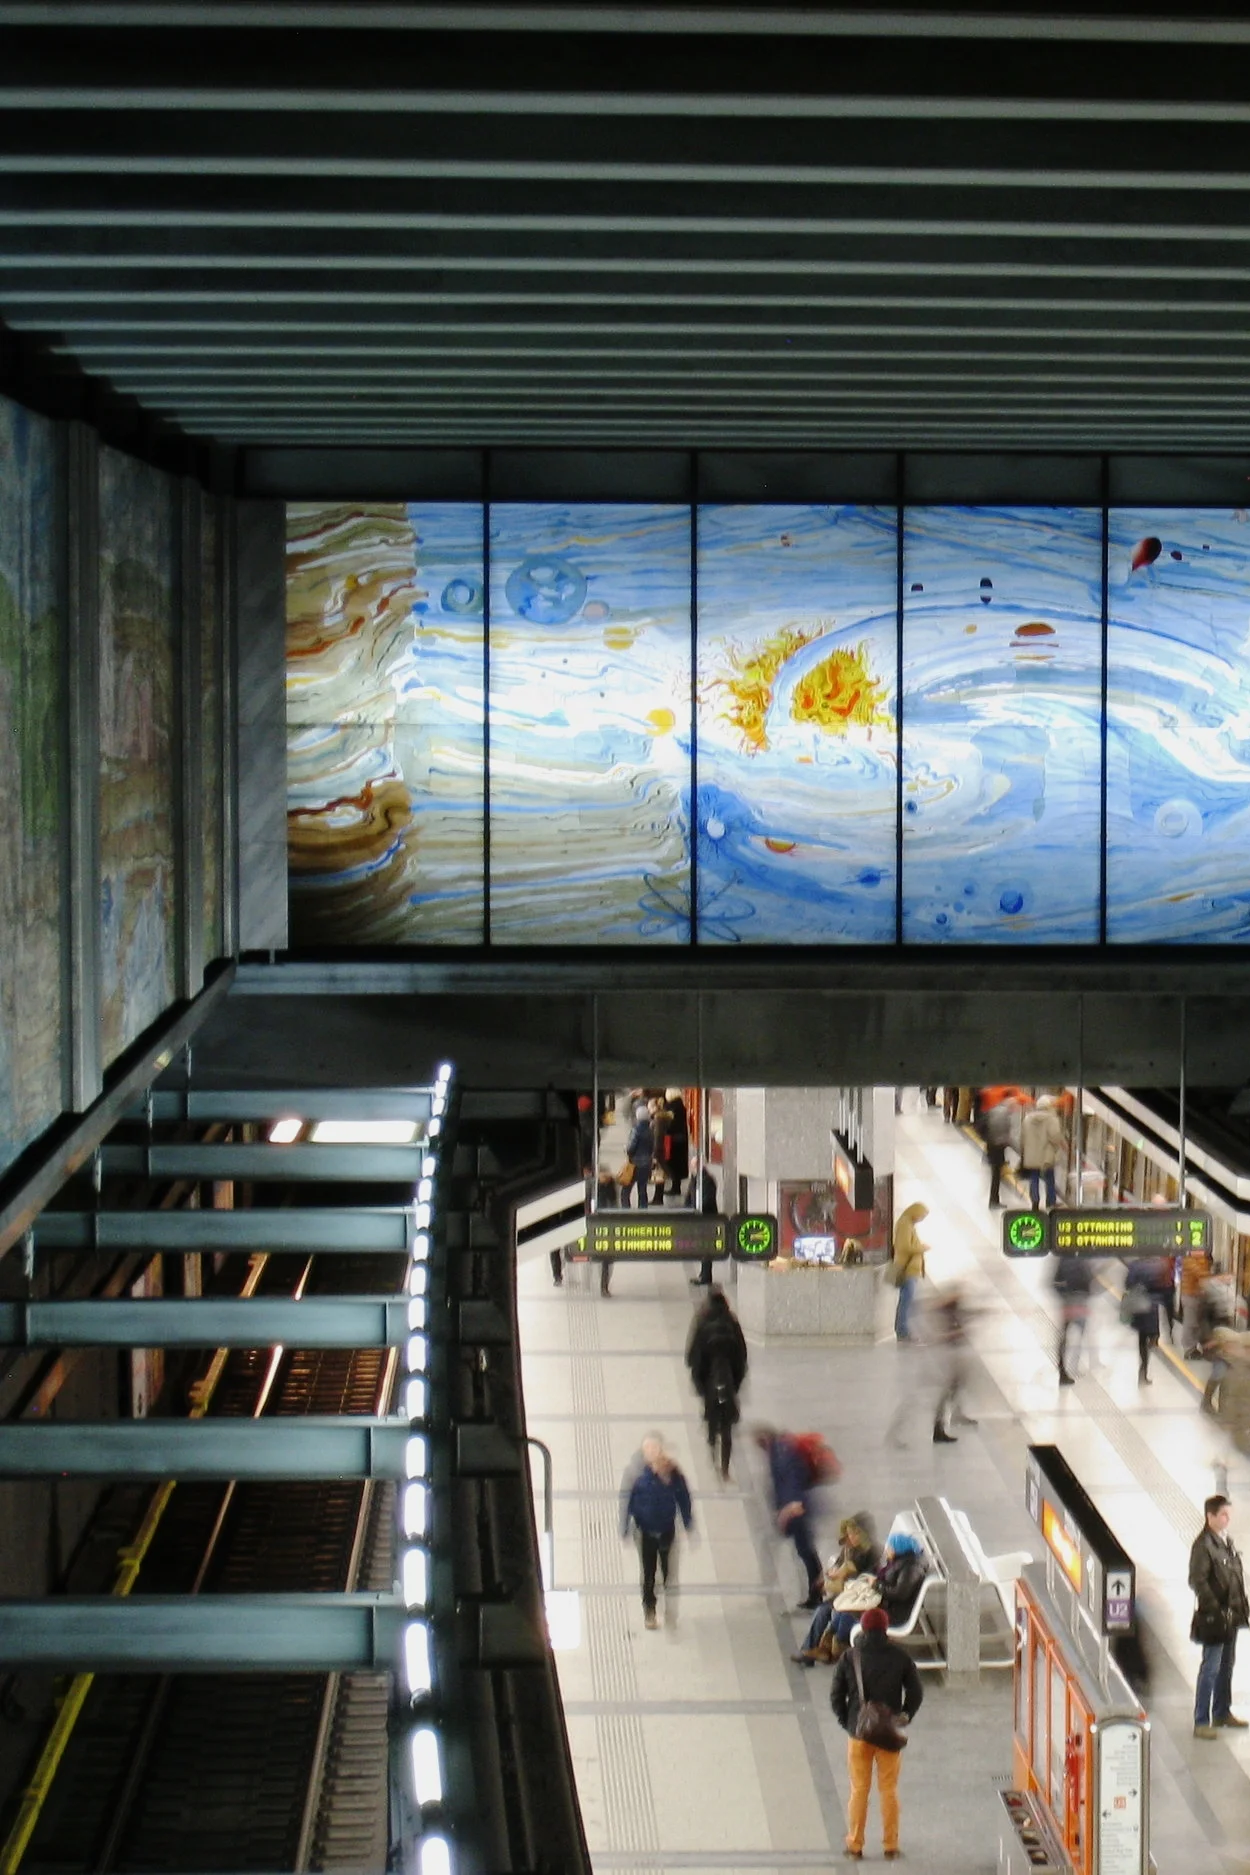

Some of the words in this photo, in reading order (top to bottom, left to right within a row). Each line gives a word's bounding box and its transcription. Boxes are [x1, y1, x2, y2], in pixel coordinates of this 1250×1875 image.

[614, 1226, 672, 1237] SIMMERING
[1076, 1221, 1133, 1233] OTTAKRING
[614, 1239, 672, 1251] SIMMERING
[1076, 1235, 1133, 1247] OTTAKRING
[1108, 1603, 1128, 1617] U2
